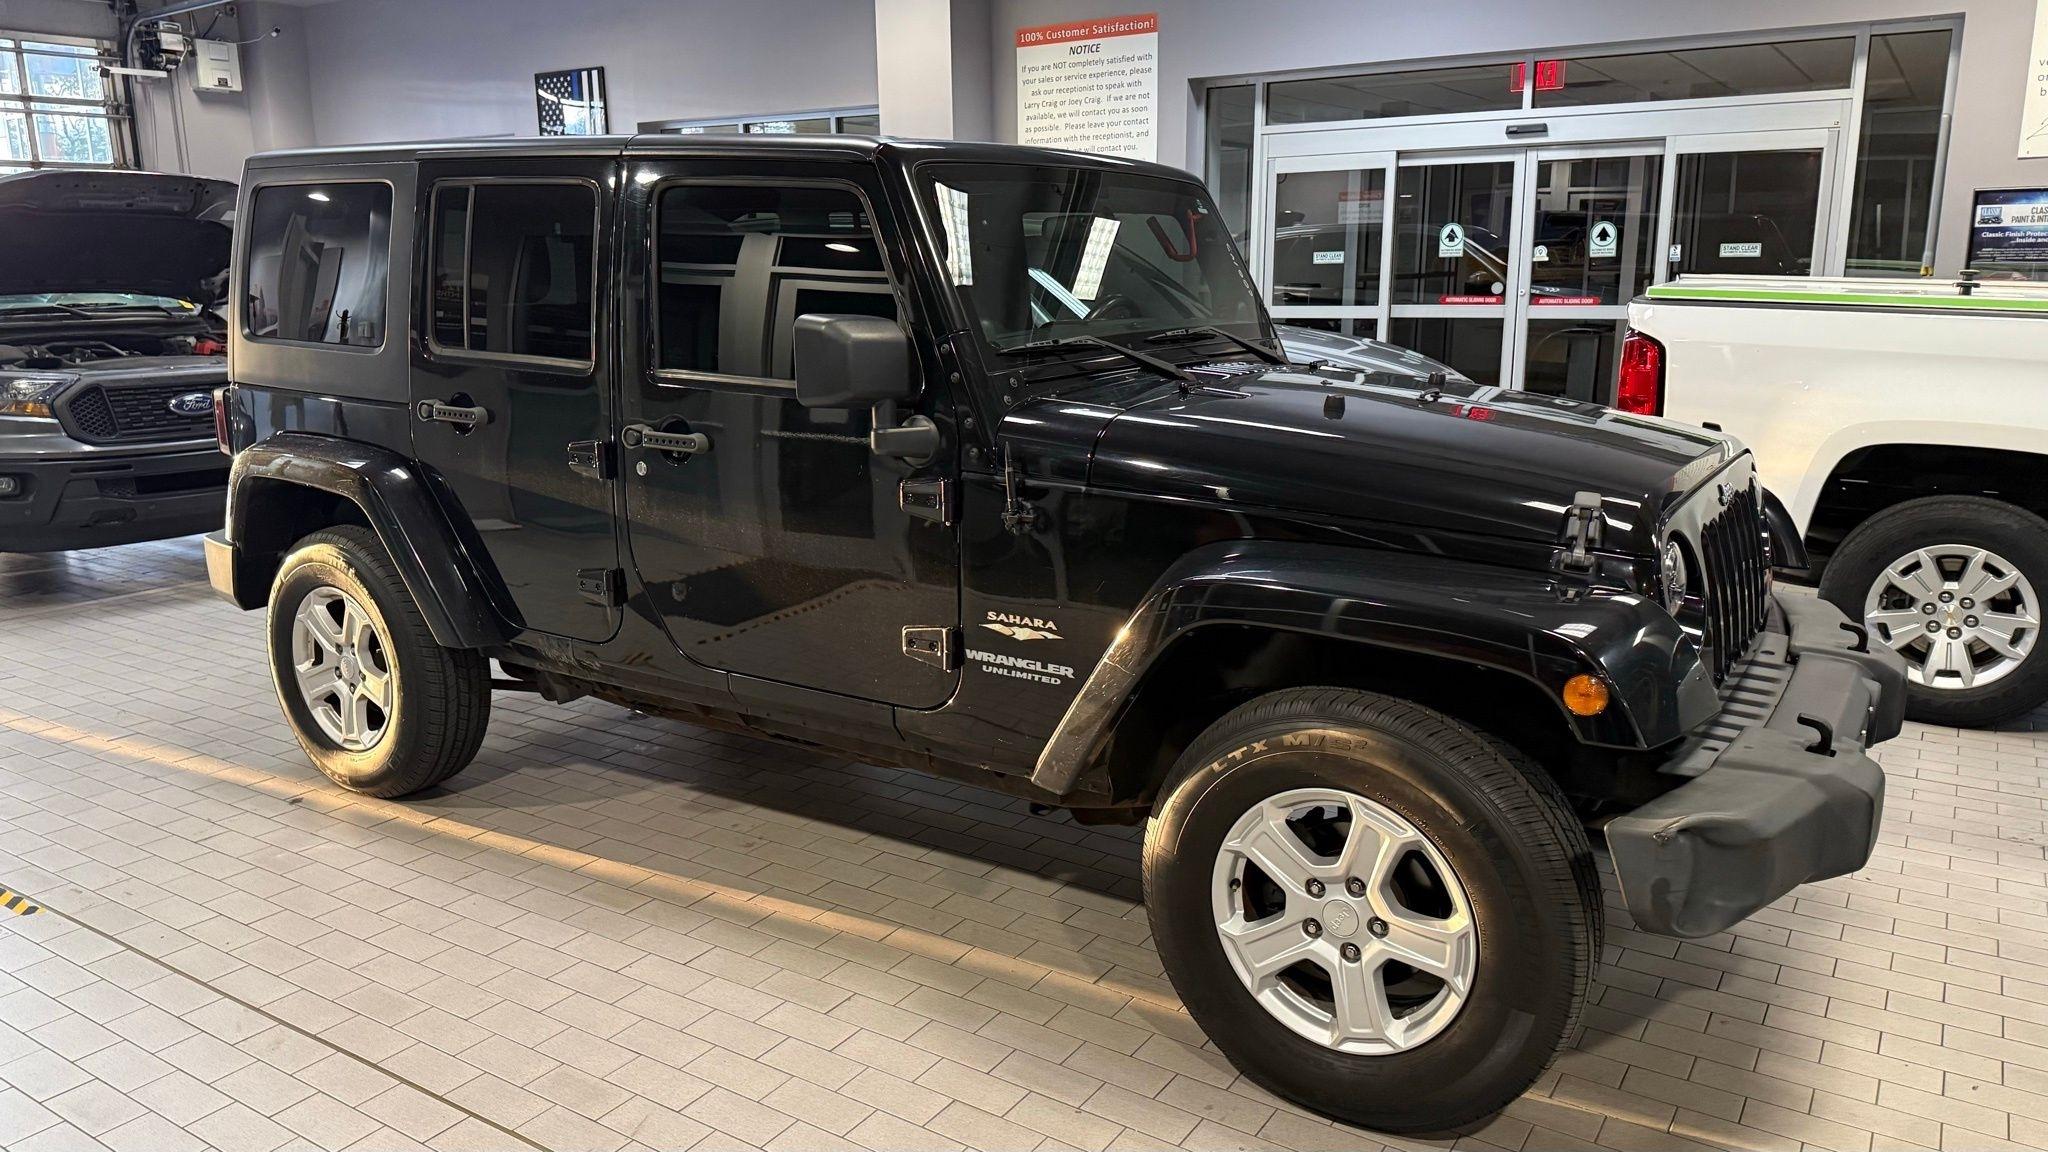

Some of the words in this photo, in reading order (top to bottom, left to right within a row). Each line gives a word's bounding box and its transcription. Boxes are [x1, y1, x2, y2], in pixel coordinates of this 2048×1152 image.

[1020, 32, 1043, 42] 100%
[1046, 28, 1089, 39] Customer
[1093, 19, 1154, 34] Satisfaction!
[1069, 43, 1101, 55] NOTICE
[1028, 66, 1040, 74] you
[1053, 62, 1066, 70] NOT
[1068, 58, 1105, 69] completely
[1106, 55, 1135, 64] satisfied
[1137, 53, 1152, 61] with
[1022, 78, 1036, 87] your
[1038, 75, 1054, 84] sales
[1064, 72, 1087, 81] service
[1088, 69, 1127, 80] experience,
[1129, 66, 1152, 76] please
[1031, 88, 1041, 96] ask
[1056, 83, 1094, 94] receptionist
[1096, 82, 1104, 90] to
[1105, 81, 1125, 90] speak
[1126, 79, 1142, 88] with
[1024, 101, 1040, 110] Larry
[1042, 100, 1058, 108] Craig
[1068, 98, 1082, 106] Joey
[1084, 96, 1102, 105] Craig.
[1106, 94, 1112, 102] If
[1138, 92, 1150, 100] not
[1026, 112, 1055, 121] available,
[1068, 109, 1080, 118] will
[1082, 108, 1106, 117] contact
[1108, 108, 1120, 116] you
[1131, 105, 1148, 113] soon
[1034, 124, 1060, 134] possible.
[1064, 122, 1086, 130] Please
[1087, 121, 1104, 129] leave
[1106, 120, 1122, 129] your
[1123, 117, 1149, 126] contact
[1025, 136, 1062, 144] information
[1064, 134, 1078, 142] with
[1080, 133, 1090, 141] the
[1092, 130, 1134, 141] receptionist,
[1136, 129, 1149, 137] and
[1097, 144, 1121, 152] contact
[1123, 144, 1138, 152] you.
[183, 399, 211, 411] Ford
[986, 611, 1058, 631] SAHARA
[965, 648, 1075, 679] WRANGLER
[982, 664, 1062, 685] UNLIMITED
[1211, 739, 1268, 773] LTX
